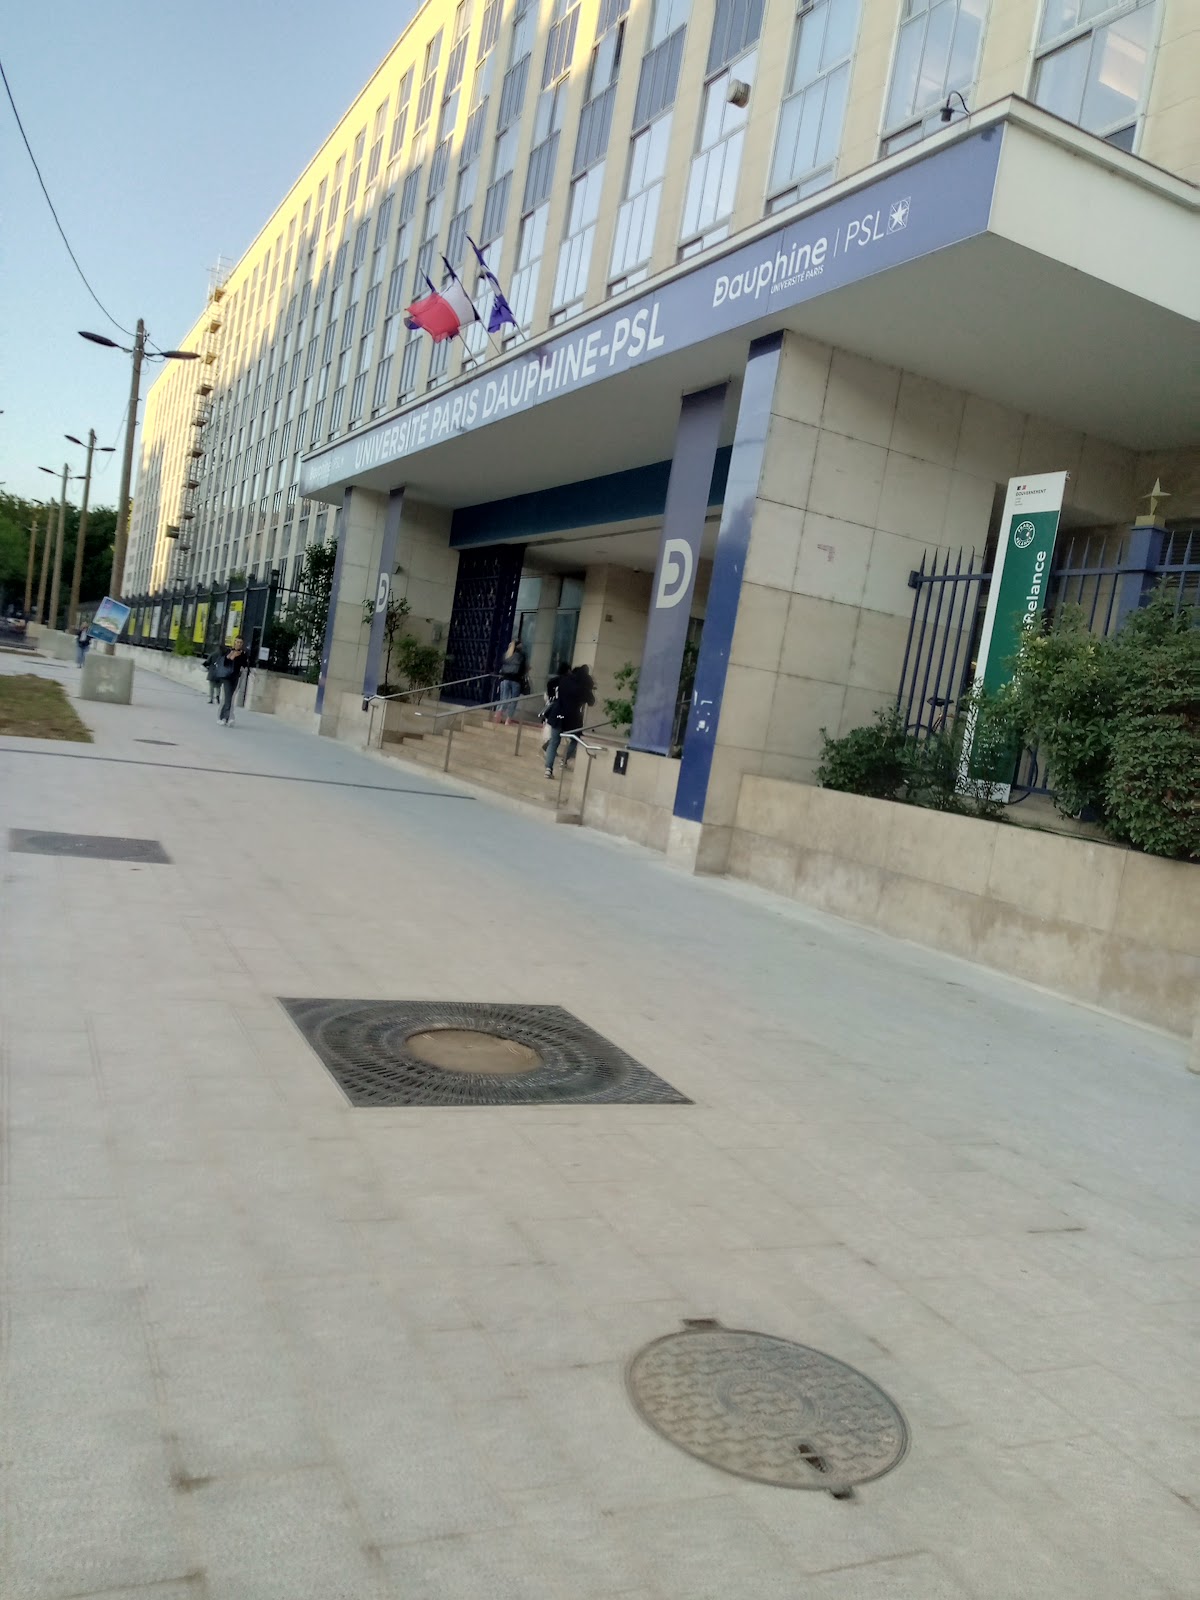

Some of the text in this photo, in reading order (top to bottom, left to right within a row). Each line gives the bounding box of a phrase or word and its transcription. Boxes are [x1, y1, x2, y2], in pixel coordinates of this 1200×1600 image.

[713, 210, 884, 308] Dauphine PSL
[771, 264, 824, 295] UNIVERSITÉ PARIS
[354, 302, 665, 469] UNIVERSITÉ PARIS DAUPHINE-PSL
[1015, 488, 1047, 497] GOUVERNEMENT
